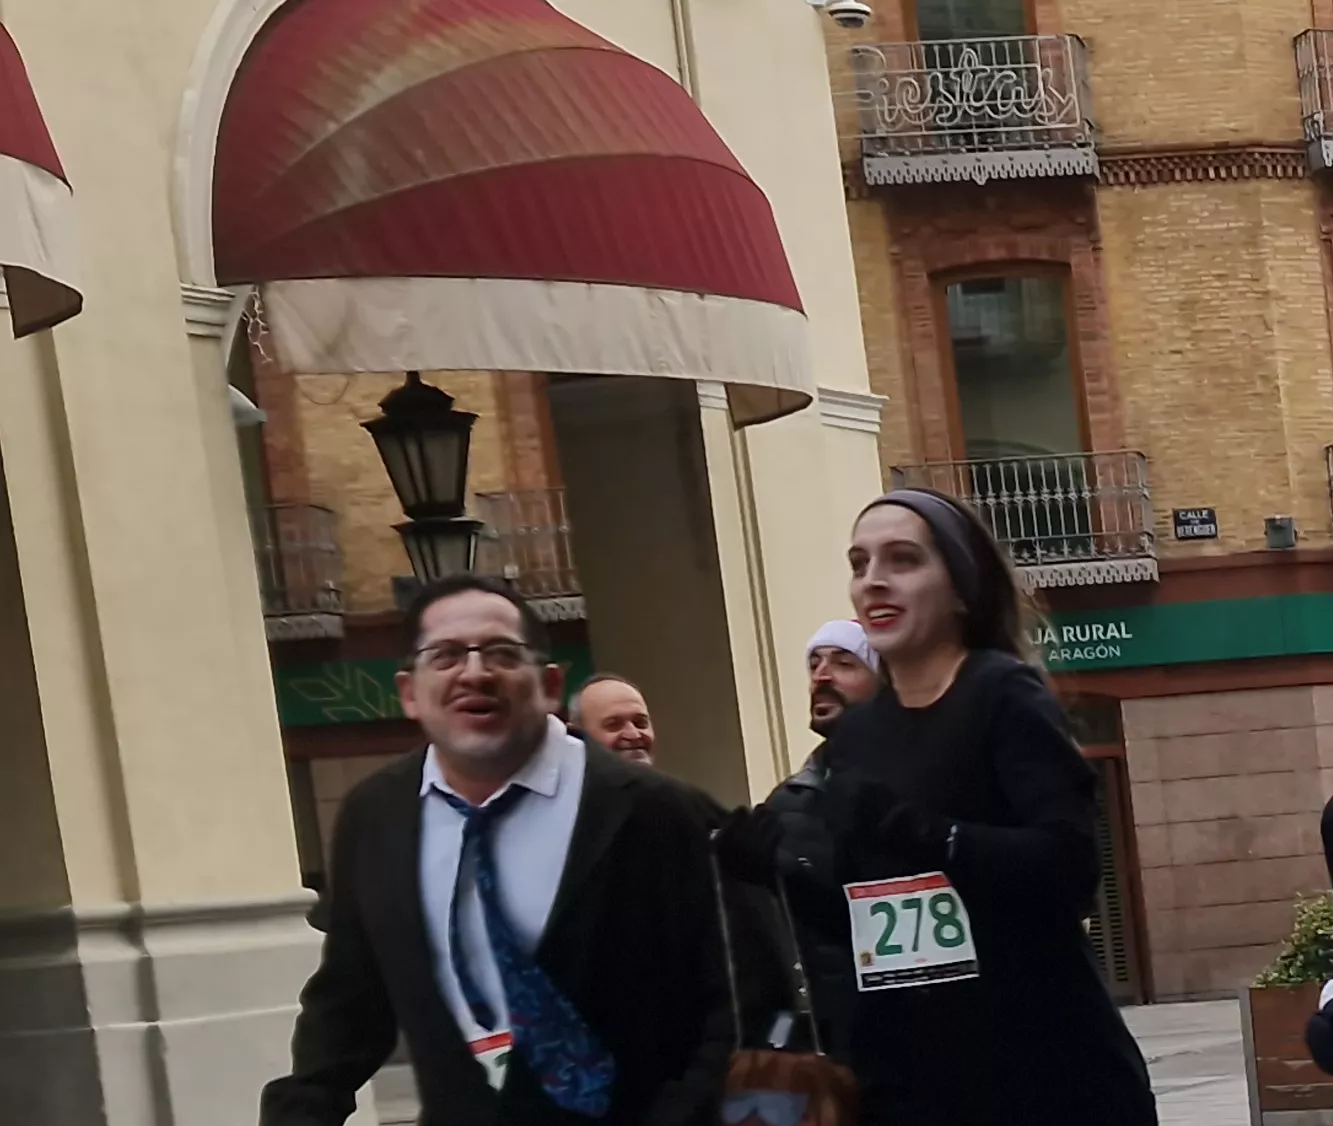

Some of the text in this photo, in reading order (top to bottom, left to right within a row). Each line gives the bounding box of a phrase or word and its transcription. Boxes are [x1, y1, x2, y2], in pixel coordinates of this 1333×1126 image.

[1179, 510, 1208, 520] CALLE
[1061, 621, 1133, 642] RURAL
[1048, 643, 1122, 661] ARAGÓN
[870, 893, 966, 956] 278
